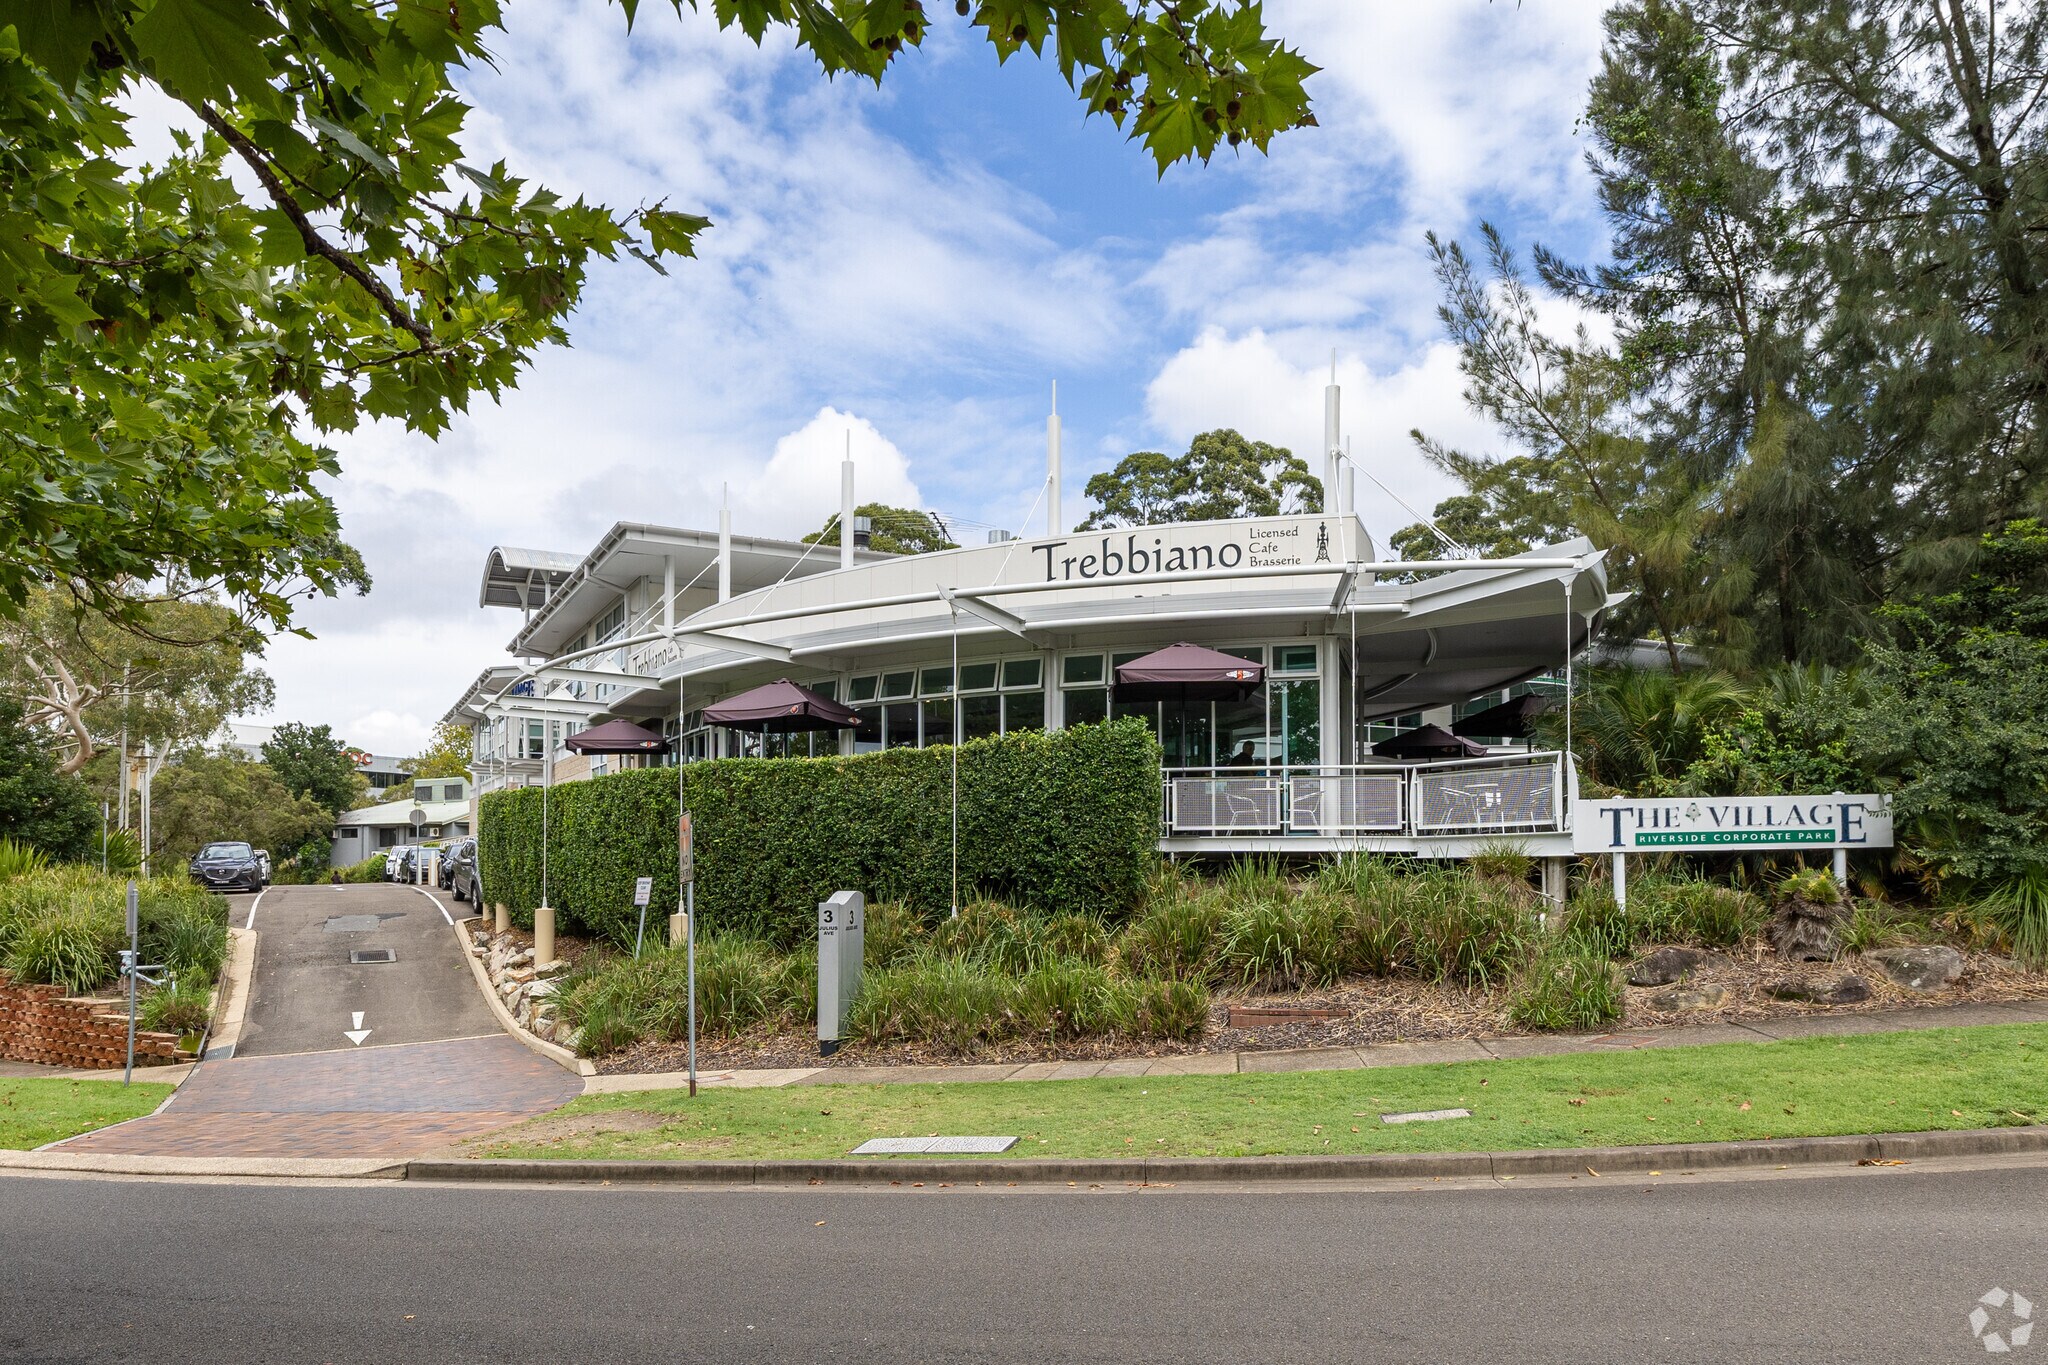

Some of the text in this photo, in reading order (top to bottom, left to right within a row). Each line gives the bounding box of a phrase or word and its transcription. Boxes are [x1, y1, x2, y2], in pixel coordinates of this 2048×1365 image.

[1250, 526, 1299, 539] Licensed
[1249, 541, 1278, 554] Cafe
[1032, 534, 1242, 582] Trebbiano
[1250, 555, 1301, 567] Brasserie
[1600, 803, 1867, 848] THE VILLAGE
[1639, 831, 1831, 843] RIVERSIDE CORPORATE PARK
[823, 910, 833, 923] 3
[849, 910, 854, 925] 3
